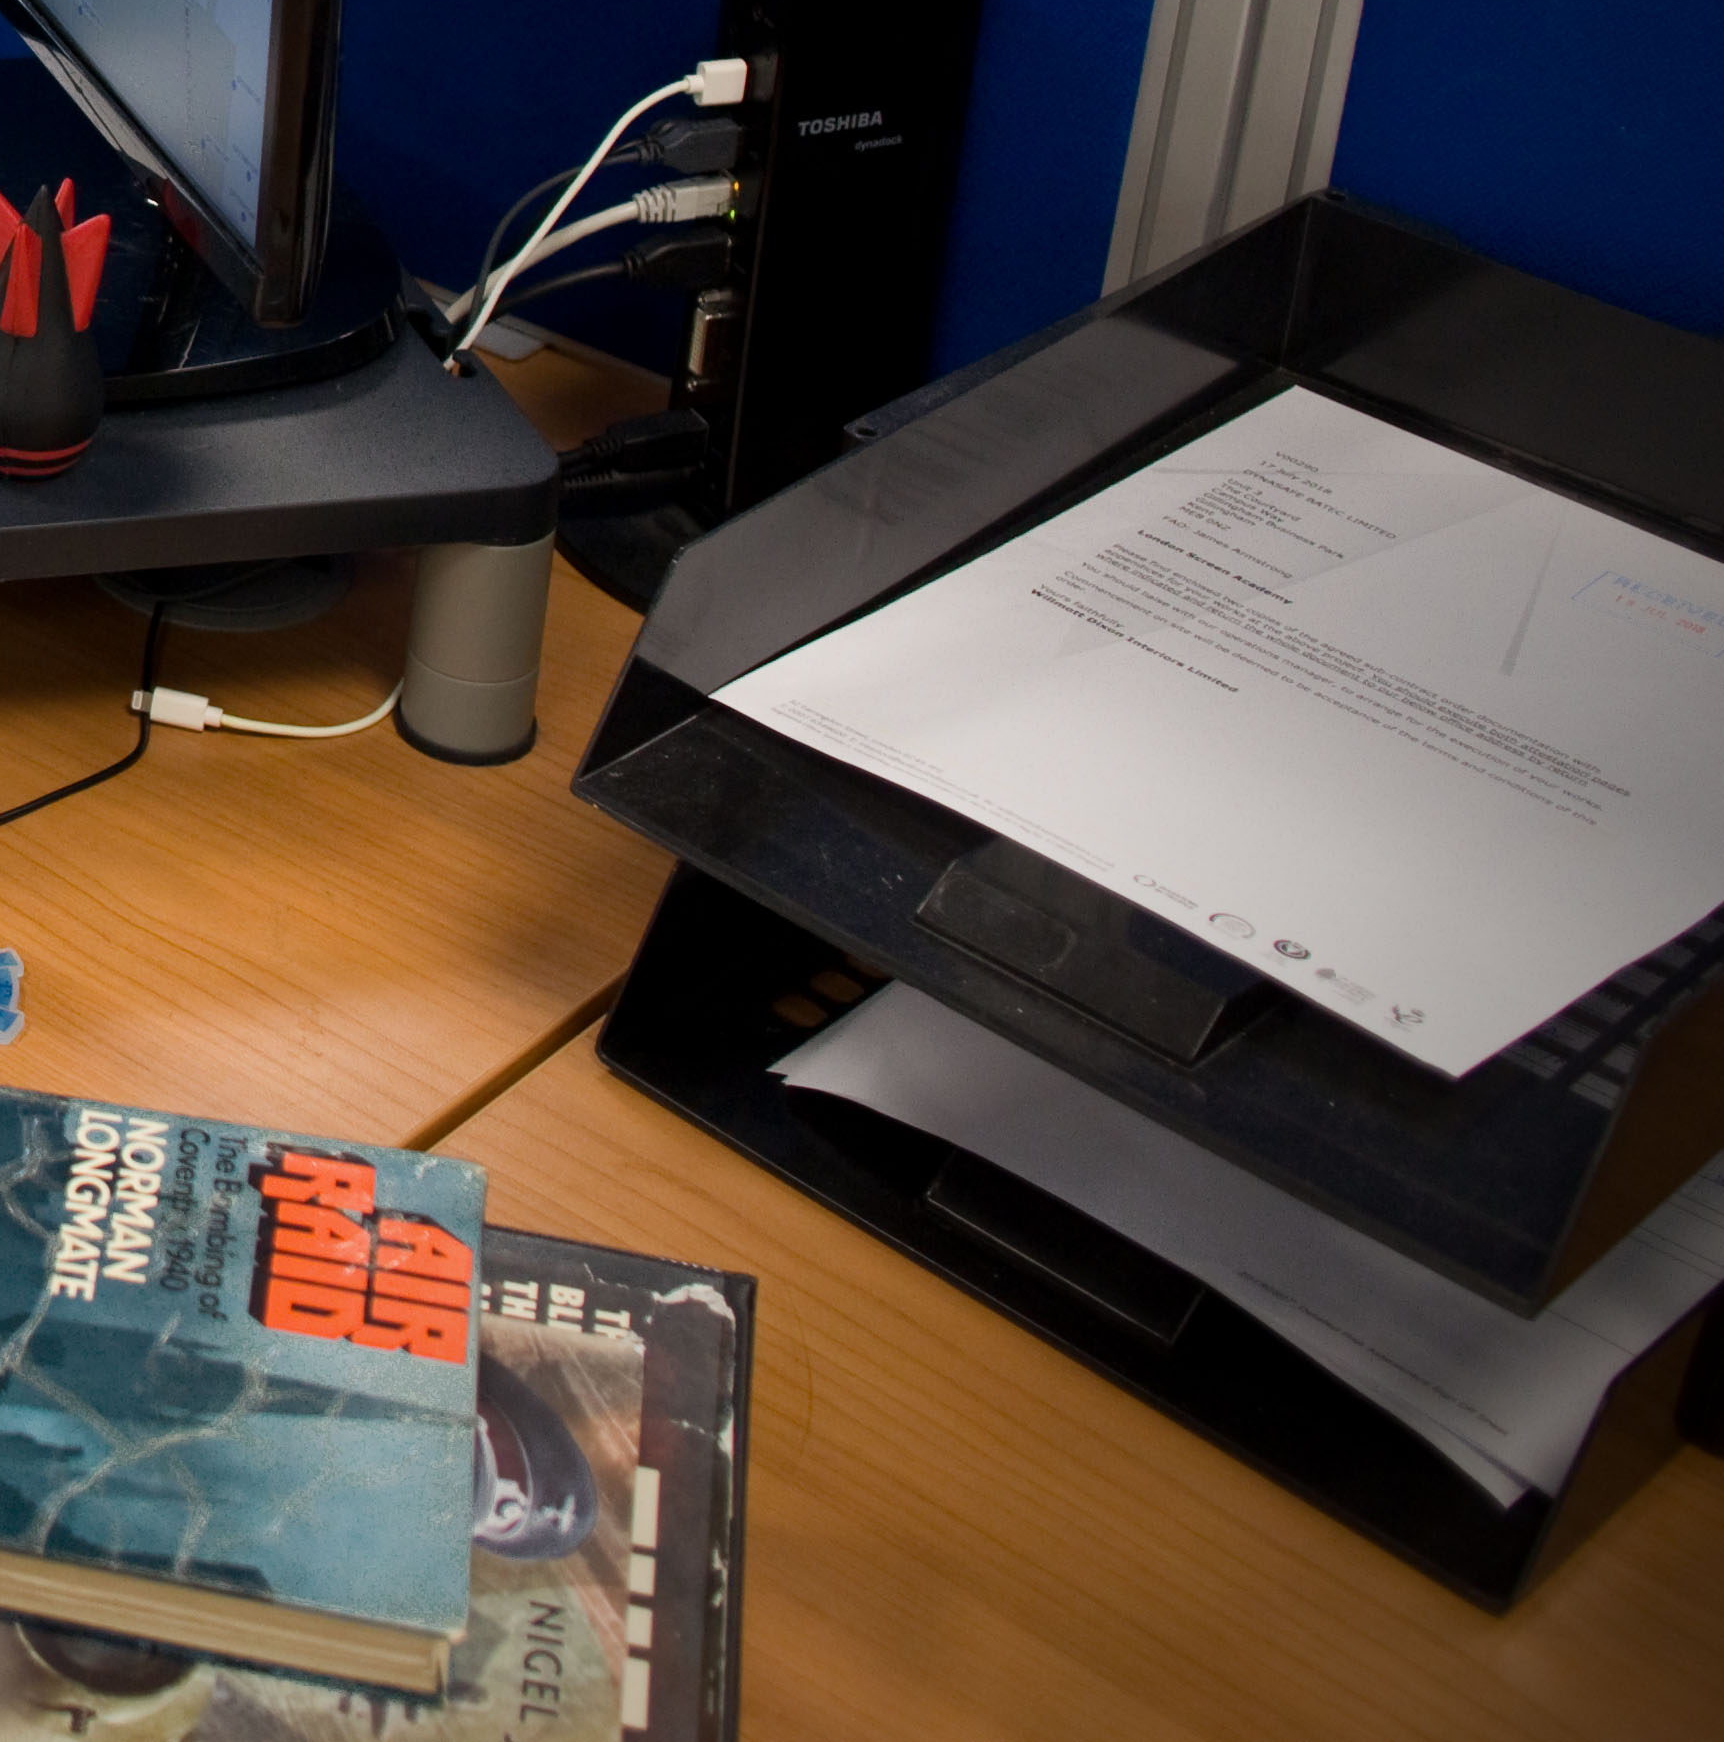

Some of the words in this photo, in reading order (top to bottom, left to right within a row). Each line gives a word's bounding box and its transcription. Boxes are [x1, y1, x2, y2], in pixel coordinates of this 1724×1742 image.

[798, 111, 882, 136] TOSHIBA
[1187, 501, 1215, 516] Kent
[1195, 497, 1256, 526] Gillingham
[1211, 488, 1257, 510] Campus
[1260, 508, 1283, 523] Way
[1243, 469, 1305, 497] DYNASAFE
[1306, 497, 1339, 515] BATEC
[1346, 515, 1397, 539] LIMITED
[1243, 494, 1302, 522] Courtyard
[1301, 479, 1333, 494] 2018
[1193, 530, 1229, 549] James
[1231, 548, 1293, 579] Armstrong
[1203, 492, 1264, 522] Gillingham
[1265, 520, 1316, 546] Business
[1318, 545, 1344, 559] Park
[1040, 584, 1072, 603] Yours
[1137, 530, 1185, 553] London
[1188, 552, 1231, 575] Screen
[1232, 575, 1293, 604] Academy
[1031, 588, 1085, 618] Willmott
[1086, 617, 1124, 638] Dixon
[1127, 636, 1185, 667] Interiors
[1187, 666, 1239, 693] Limited
[1064, 571, 1153, 616] Commencement
[1313, 692, 1382, 724] acceptance
[1422, 741, 1459, 762] terms
[1487, 773, 1554, 805] conditions
[1320, 643, 1363, 664] agreed
[1363, 662, 1438, 699] sub-contract
[1440, 698, 1475, 714] order
[1476, 714, 1570, 760] documentation
[1355, 694, 1403, 717] arrange
[1449, 737, 1511, 767] execution
[215, 1136, 248, 1174] The
[52, 1110, 123, 1302] LONGMATE
[104, 1116, 169, 1284] NORMAN
[194, 1177, 243, 1288] Bombing
[255, 1148, 376, 1342] RAID
[160, 1238, 194, 1291] 1940
[352, 1215, 474, 1365] AIR
[198, 1292, 228, 1322] of
[500, 1280, 539, 1321] TH
[547, 1283, 586, 1333] BLI
[519, 1600, 563, 1724] NIGEL
